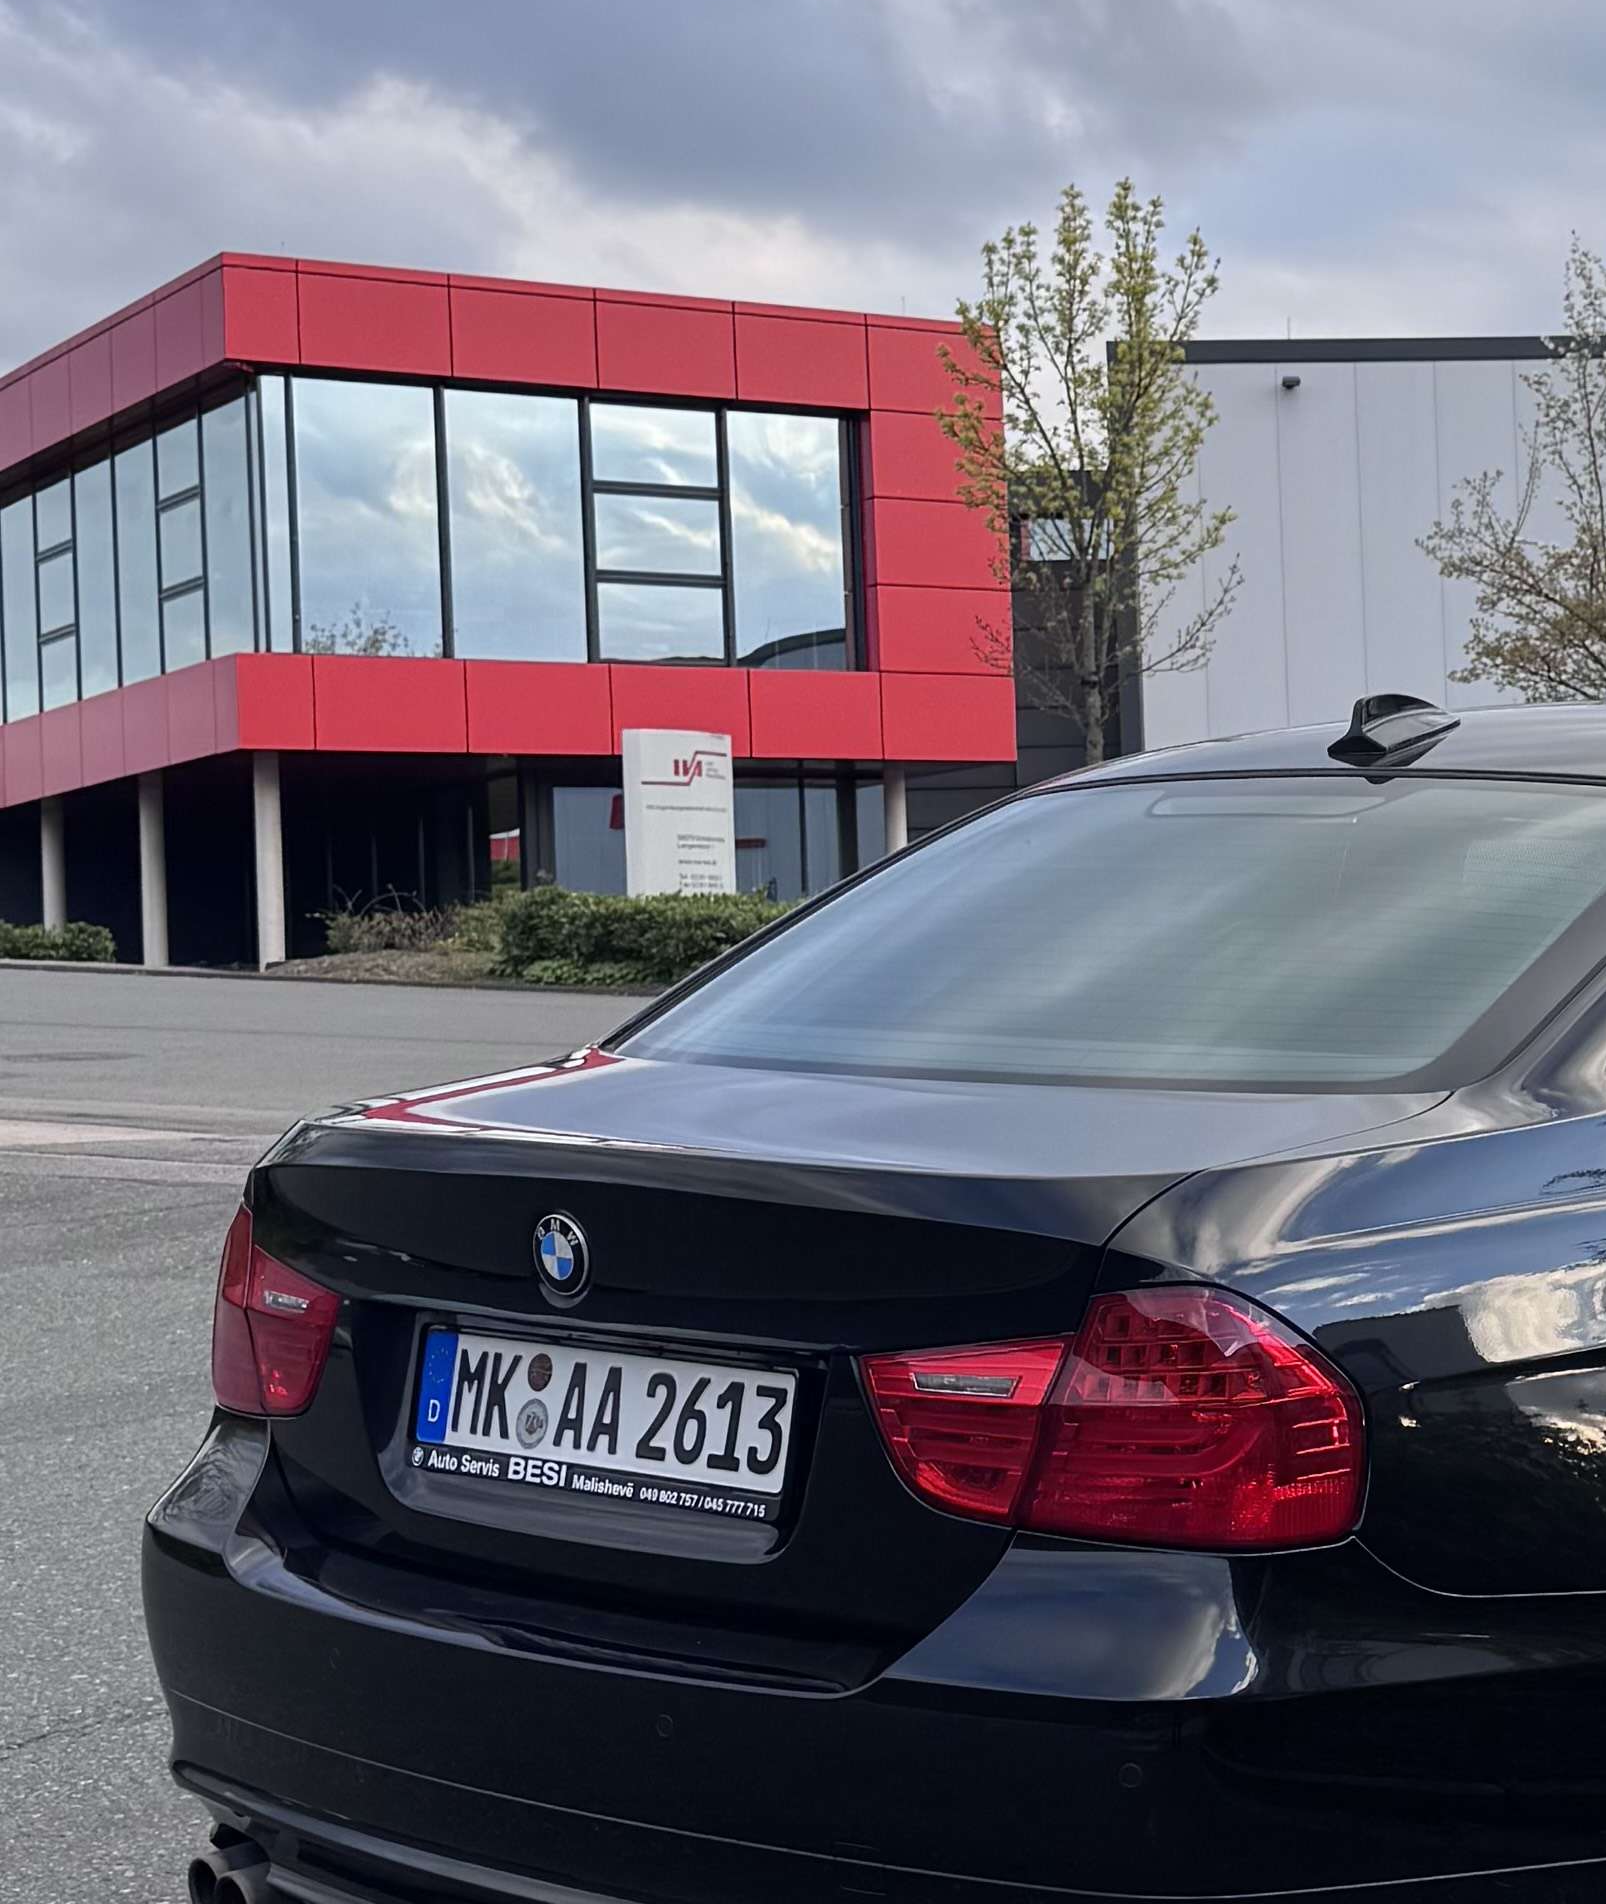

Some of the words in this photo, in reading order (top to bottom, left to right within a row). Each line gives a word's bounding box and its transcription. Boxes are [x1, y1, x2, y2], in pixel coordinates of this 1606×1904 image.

[537, 1219, 579, 1246] BMW
[427, 1399, 441, 1423] D
[451, 1349, 523, 1440] MK
[552, 1362, 623, 1455] AA
[635, 1372, 788, 1475] 2613
[428, 1450, 458, 1471] Auto
[461, 1455, 500, 1477] Servis
[507, 1456, 568, 1487] BESI
[725, 1500, 746, 1515] 777
